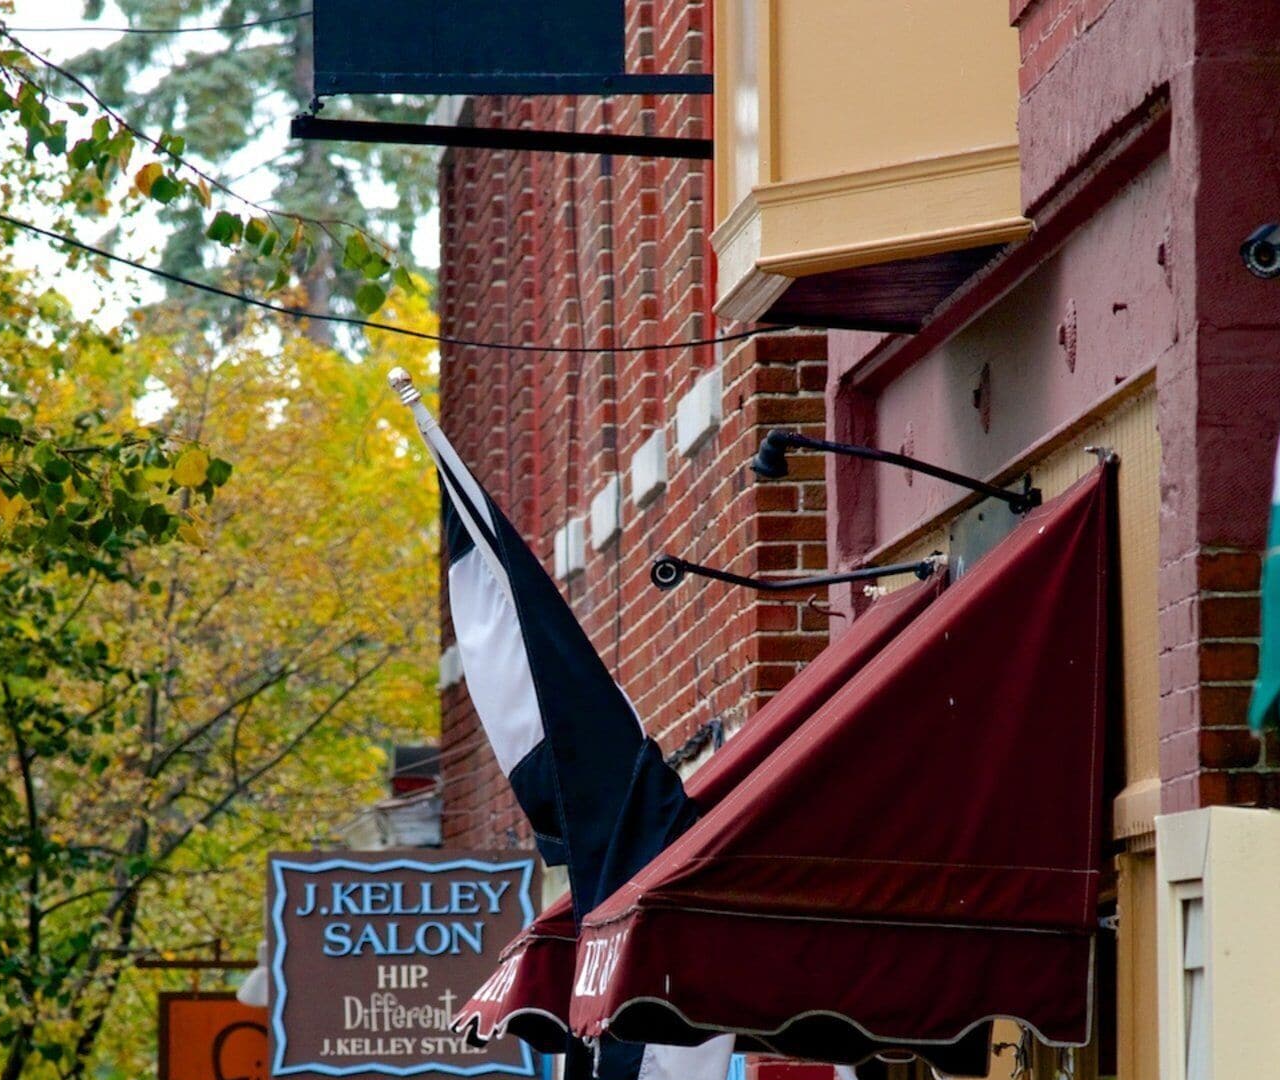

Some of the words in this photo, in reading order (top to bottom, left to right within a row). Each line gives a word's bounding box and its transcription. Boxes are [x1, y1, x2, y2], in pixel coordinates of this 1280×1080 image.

[296, 880, 512, 918] J.KELLEY
[322, 921, 486, 958] SALON
[376, 964, 430, 990] HIP.
[344, 988, 457, 1033] Different
[320, 1037, 417, 1057] J.KELLEY
